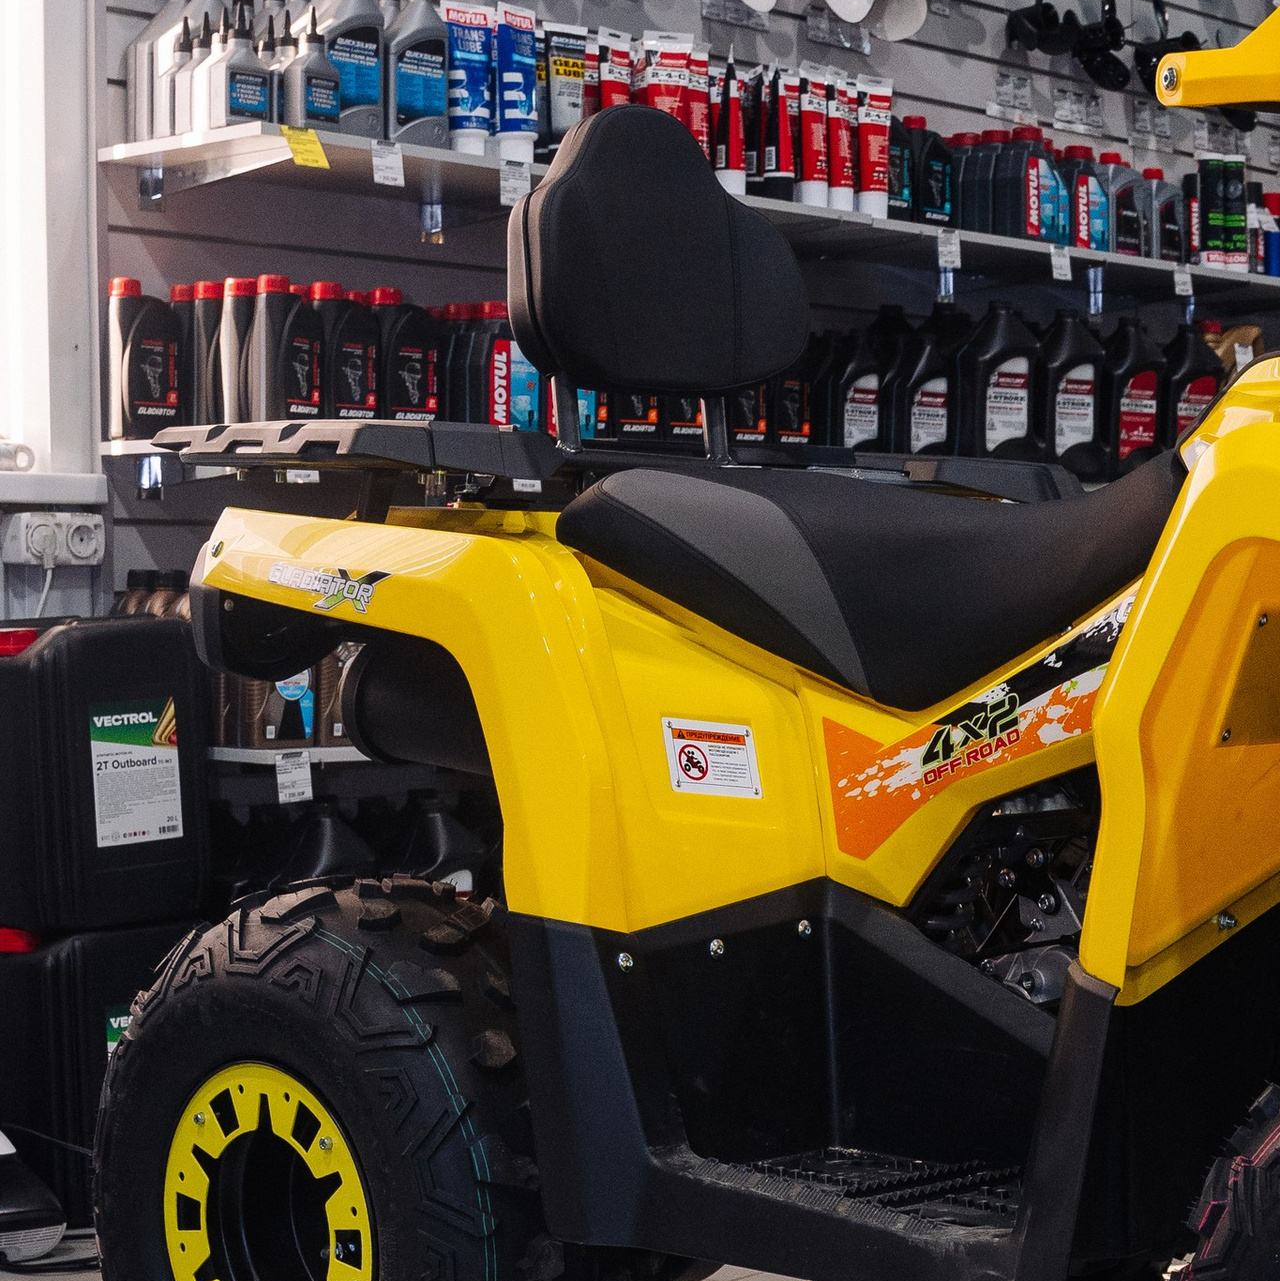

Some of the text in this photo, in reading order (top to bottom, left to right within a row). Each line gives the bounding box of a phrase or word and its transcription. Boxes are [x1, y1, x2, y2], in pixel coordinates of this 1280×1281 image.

[448, 11, 486, 26] MOTUL
[506, 13, 532, 29] MOTUL
[451, 25, 486, 41] TRANS
[458, 40, 483, 53] LUBE
[556, 69, 584, 77] LUB
[651, 71, 686, 80] 2-4-C
[1029, 167, 1039, 226] MOTUL
[1079, 184, 1088, 241] MOTUL
[494, 351, 507, 424] MOTUL
[138, 406, 176, 416] GLADIATOR
[290, 405, 319, 415] GLADIATOR
[339, 409, 374, 418] GLADIATOR
[395, 411, 435, 420] GLADIATOR
[623, 424, 655, 433] GLADIATOR
[269, 563, 374, 604] GLADIATOR
[93, 711, 158, 728] VECTROL
[97, 761, 108, 771] 2T
[112, 756, 157, 769] Outboard
[923, 728, 1020, 785] OFF ROAD
